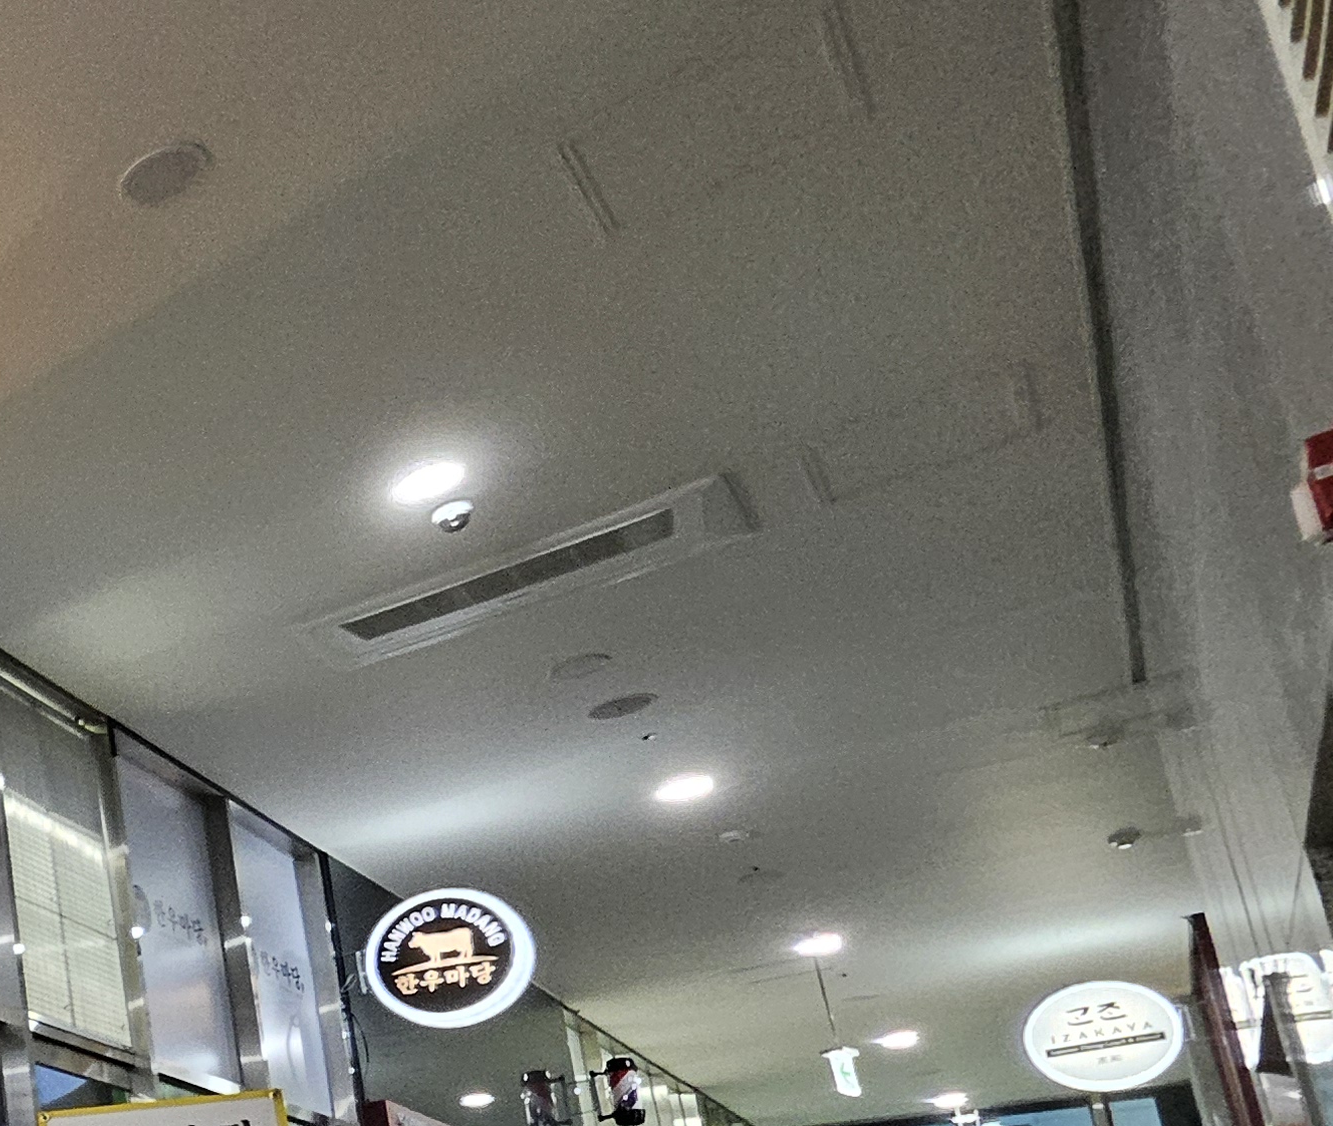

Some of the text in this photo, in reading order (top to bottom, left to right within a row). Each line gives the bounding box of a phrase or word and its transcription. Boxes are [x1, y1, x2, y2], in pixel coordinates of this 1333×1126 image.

[381, 903, 506, 962] HANWOO MADANG
[394, 961, 496, 995] 한우마당
[1051, 1021, 1153, 1044] IZAKAYA
